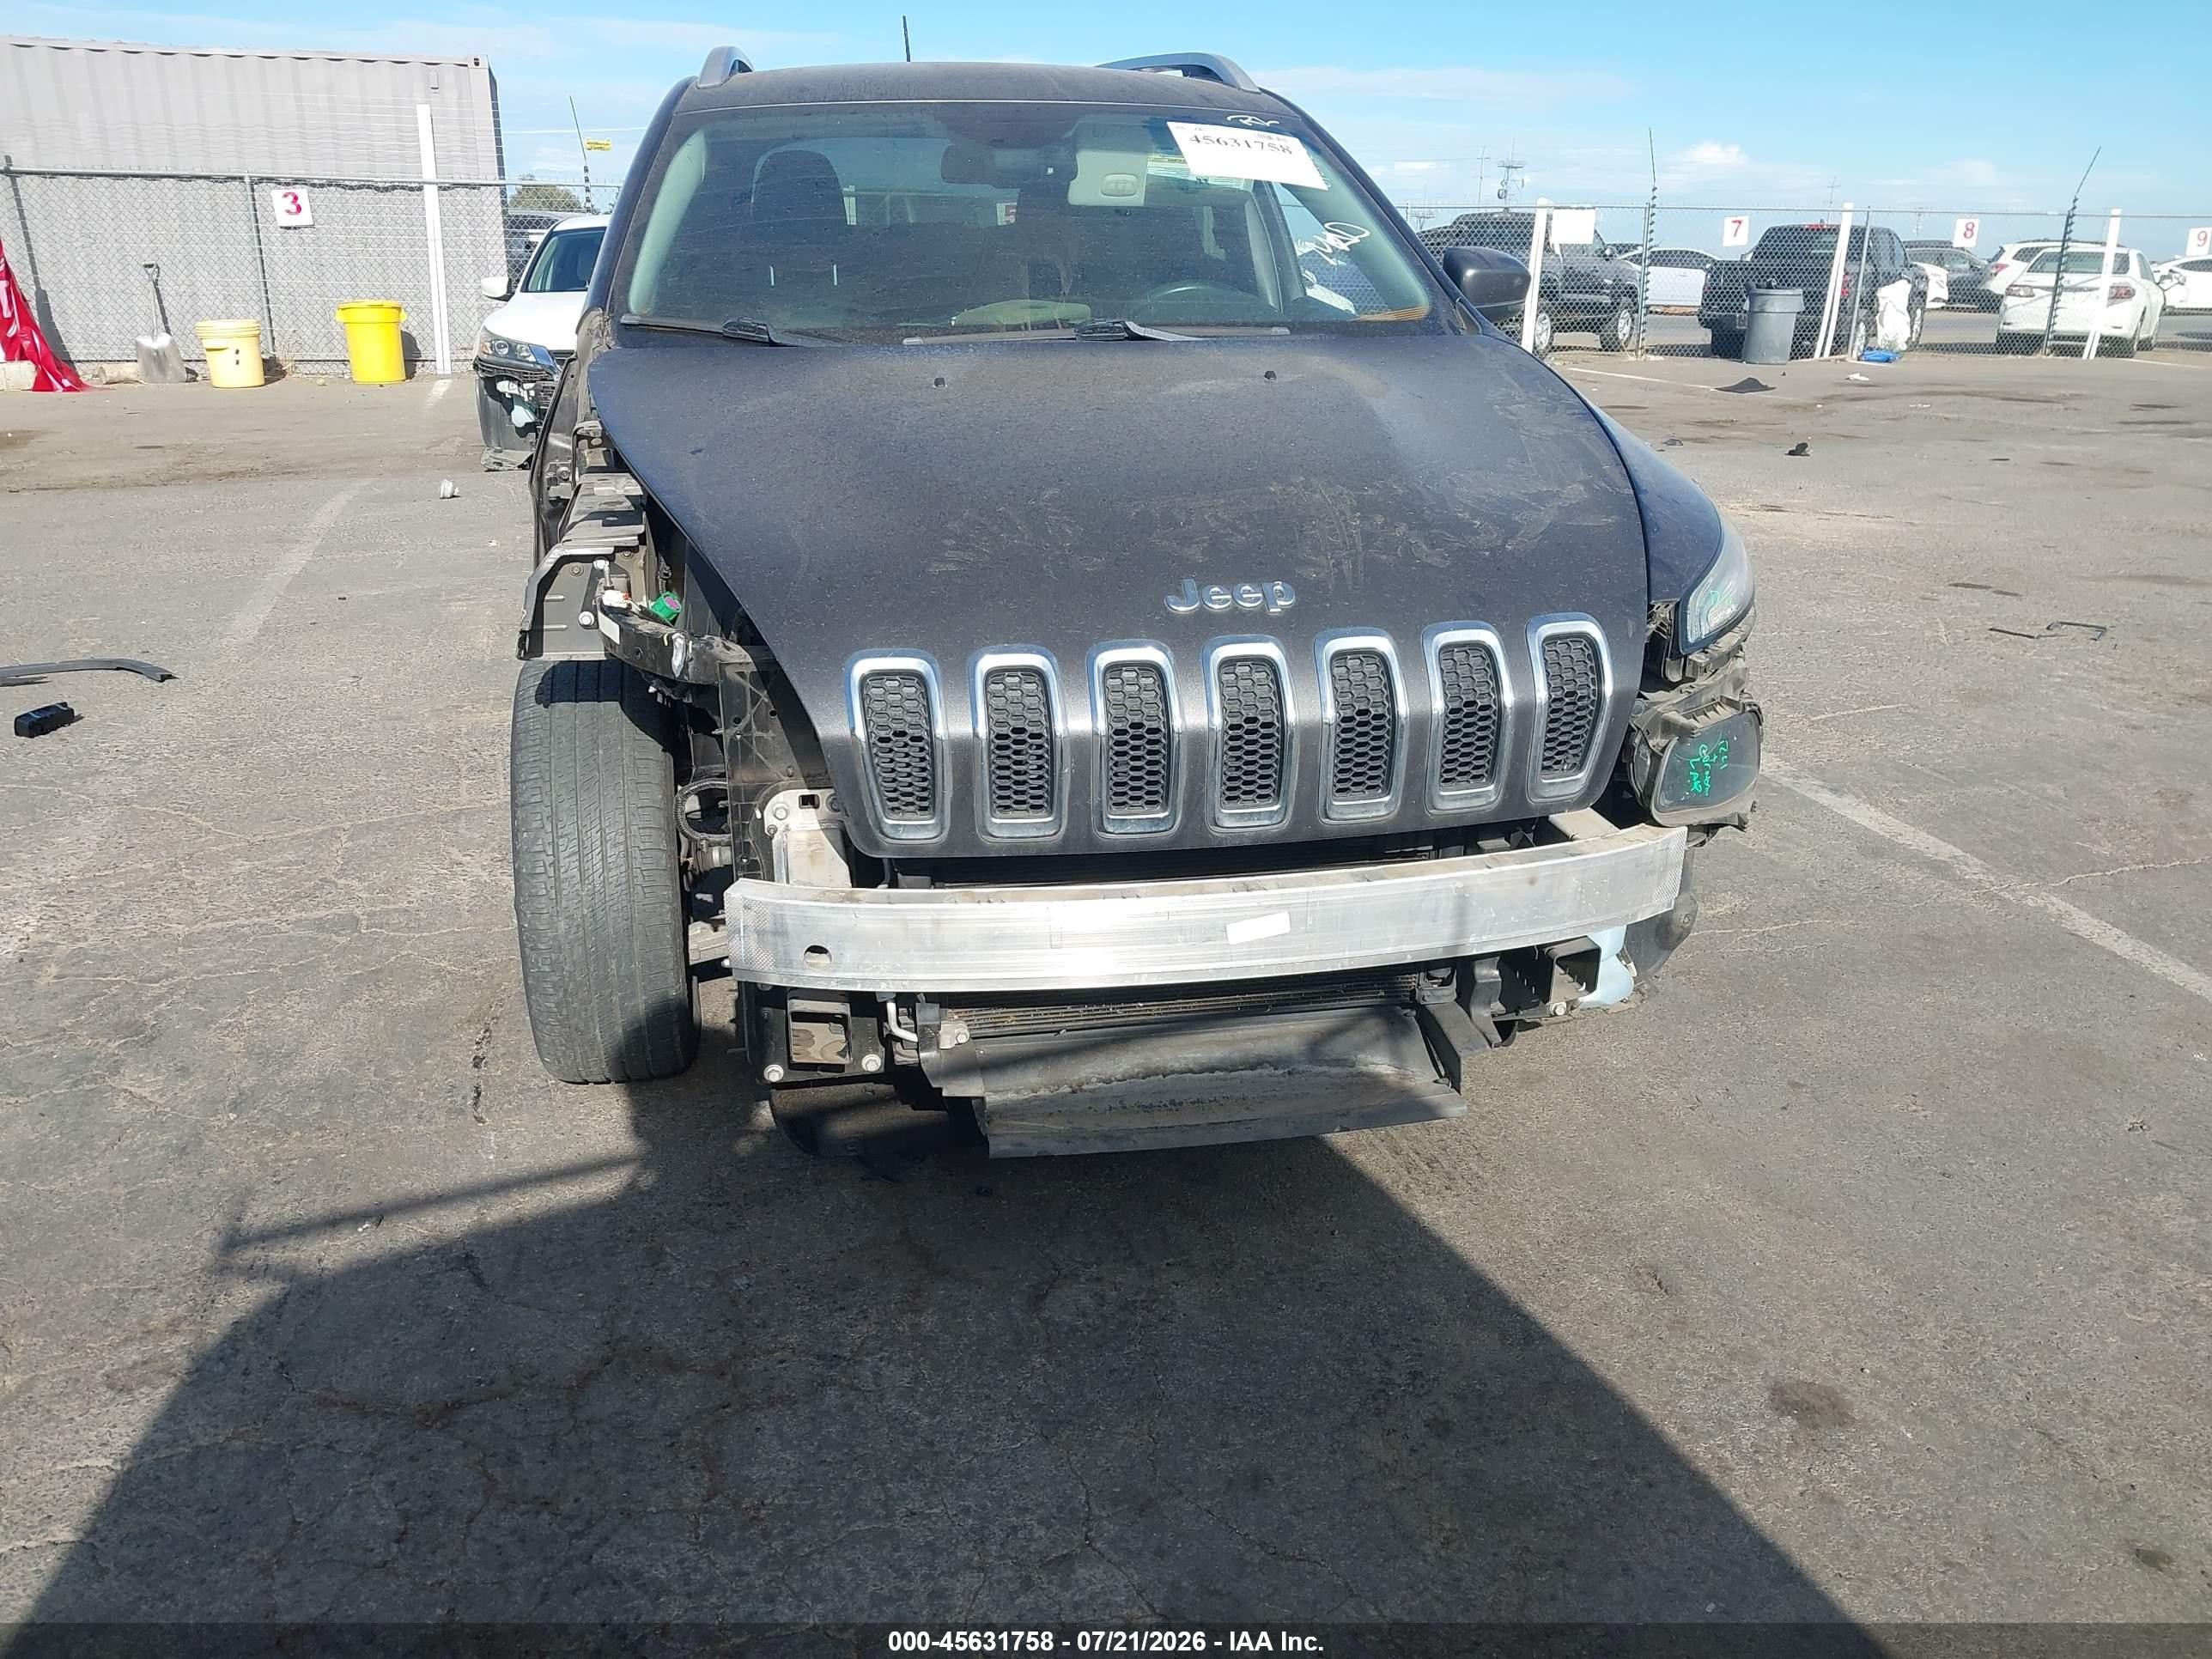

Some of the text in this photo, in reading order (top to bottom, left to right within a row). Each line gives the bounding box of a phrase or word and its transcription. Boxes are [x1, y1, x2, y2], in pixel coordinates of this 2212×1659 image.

[1188, 134, 1293, 155] 45631758
[282, 191, 302, 216] 3
[1731, 219, 1743, 238] 7
[1963, 222, 1975, 239] 8
[2197, 230, 2208, 247] 9
[1164, 578, 1296, 616] Jeep
